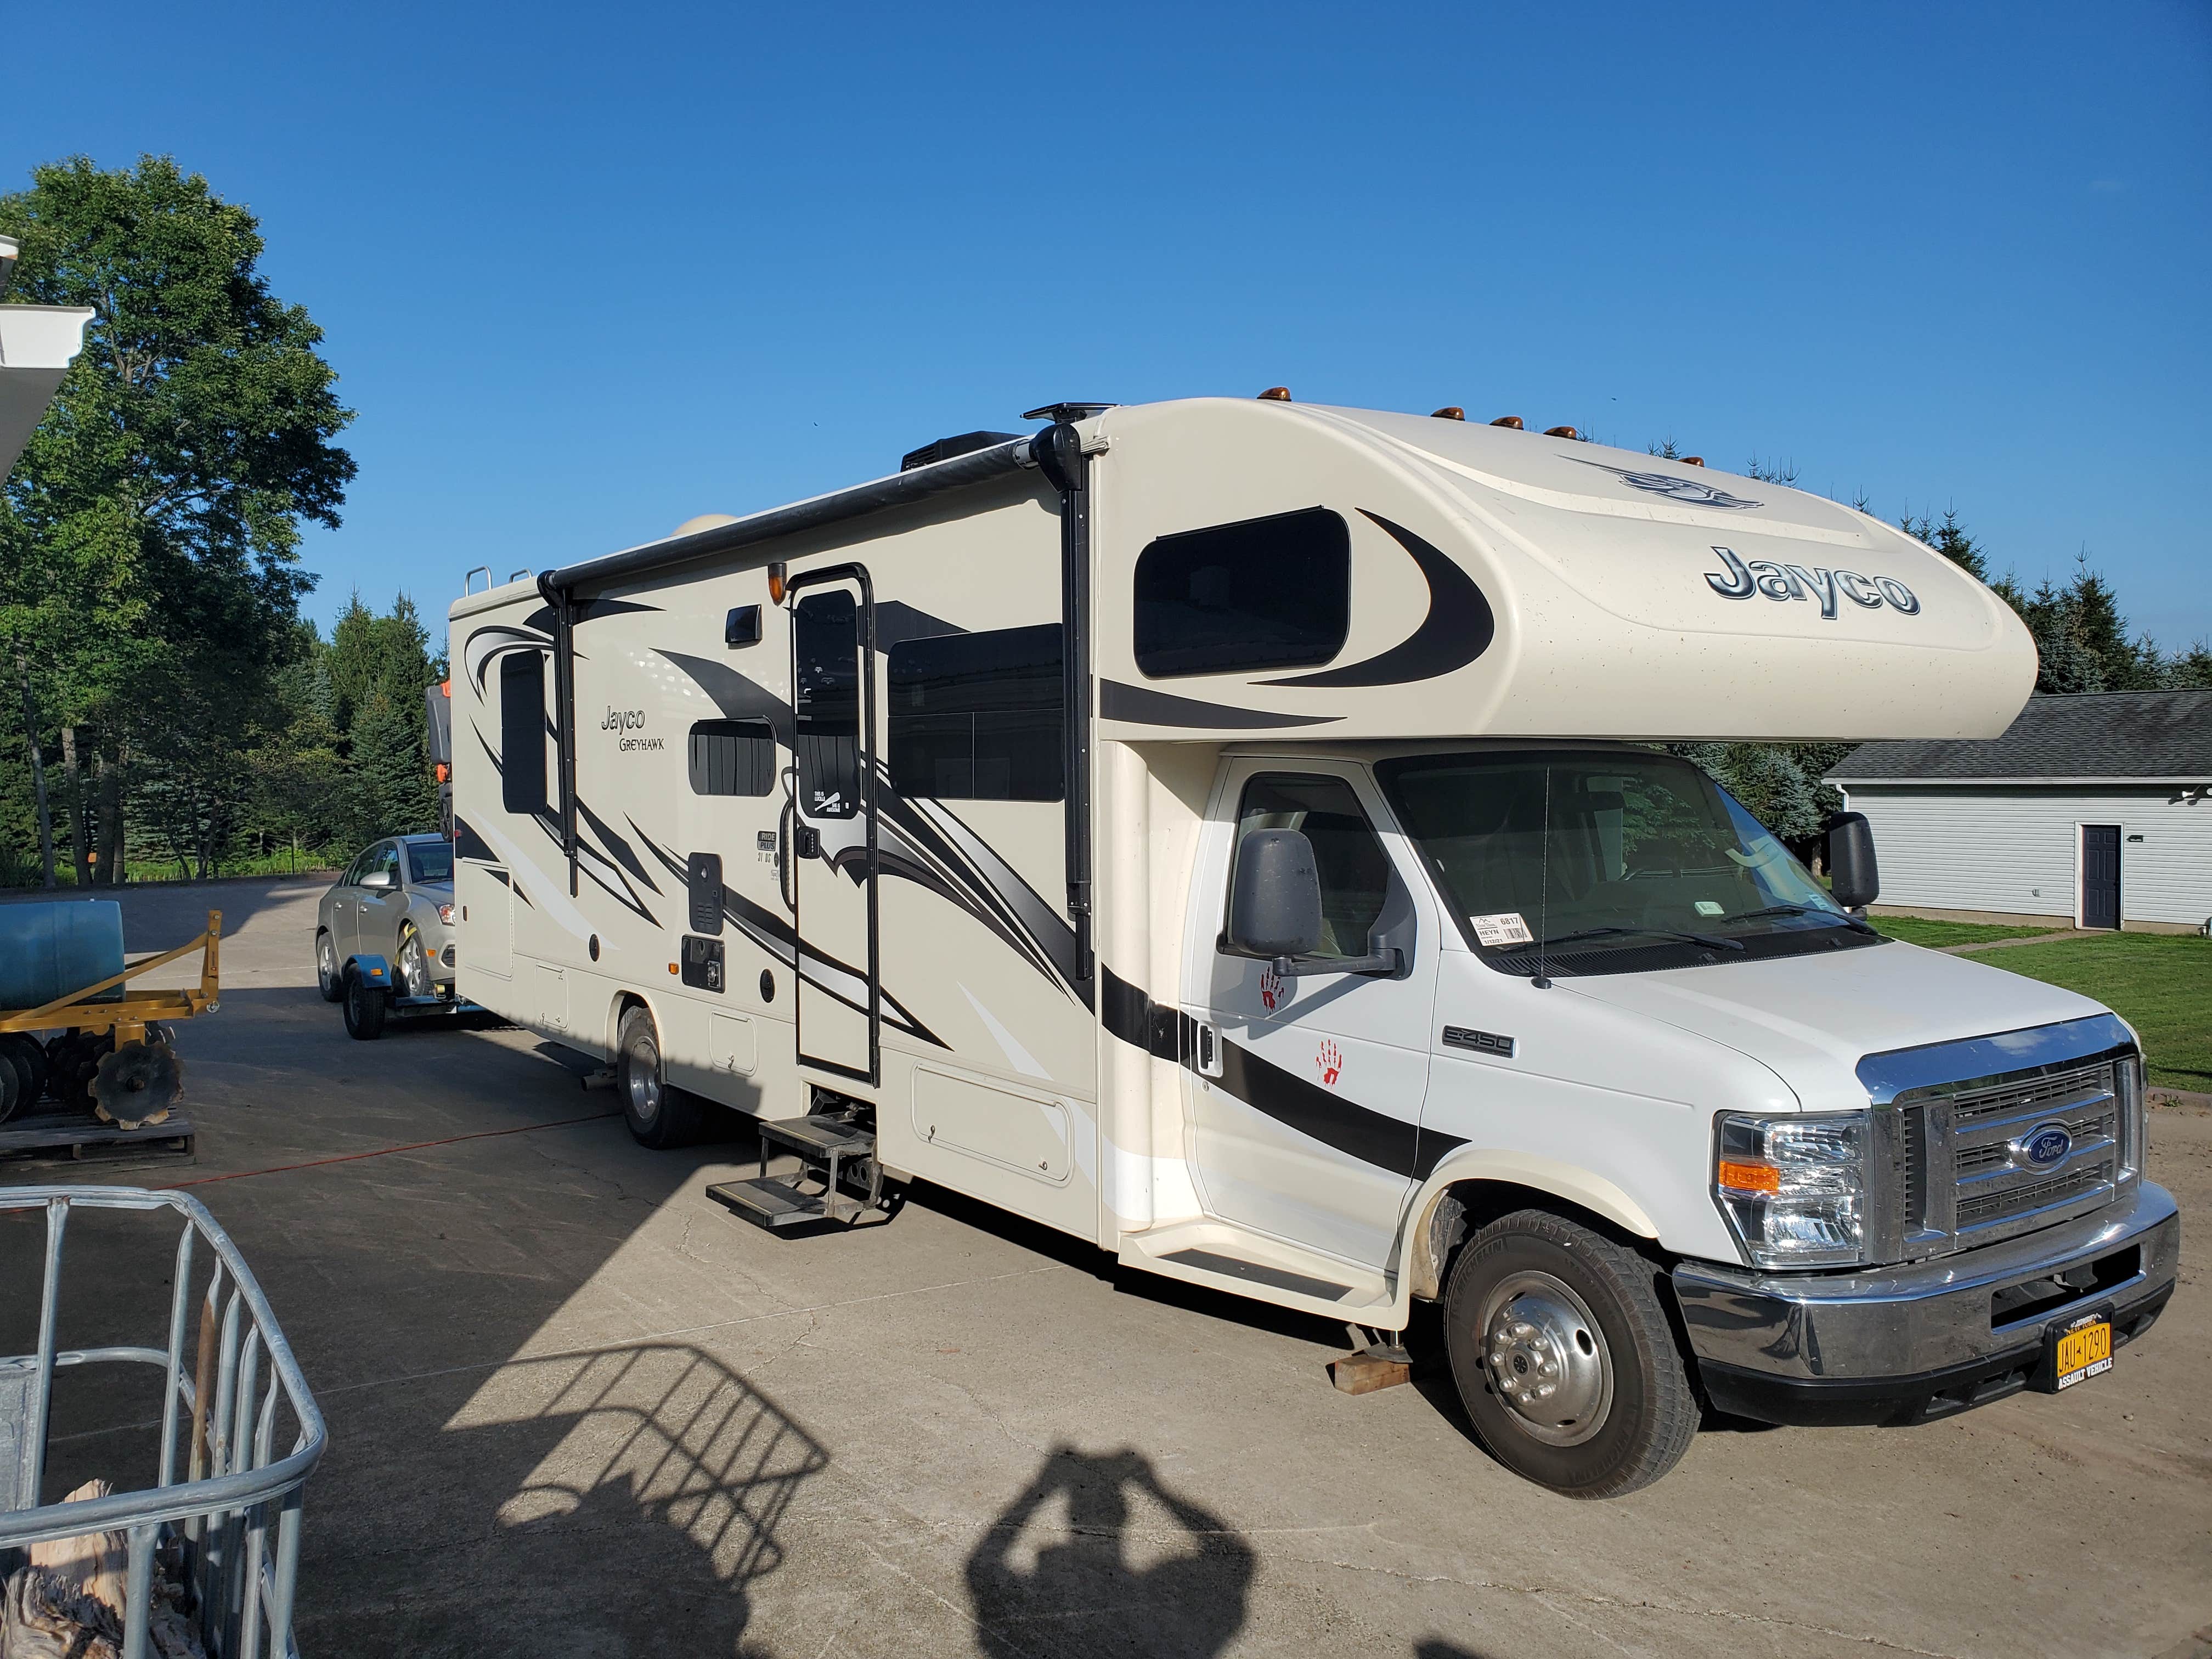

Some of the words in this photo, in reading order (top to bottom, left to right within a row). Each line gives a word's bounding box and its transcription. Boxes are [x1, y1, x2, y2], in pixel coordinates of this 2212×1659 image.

[1703, 546, 1921, 620] Jayco
[601, 706, 645, 735] Jayco
[619, 738, 664, 751] GREYHAWK
[760, 842, 775, 850] PLUS
[761, 832, 775, 841] RIDE
[758, 852, 763, 862] 31
[1444, 1029, 1513, 1050] E-450
[2039, 1136, 2063, 1158] Ford
[1457, 1238, 1503, 1293] MICHELIN
[2059, 1339, 2075, 1372] JAU
[2083, 1328, 2106, 1362] 1290
[2058, 1368, 2086, 1390] ASSAULT
[2086, 1357, 2112, 1377] VEHICLE
